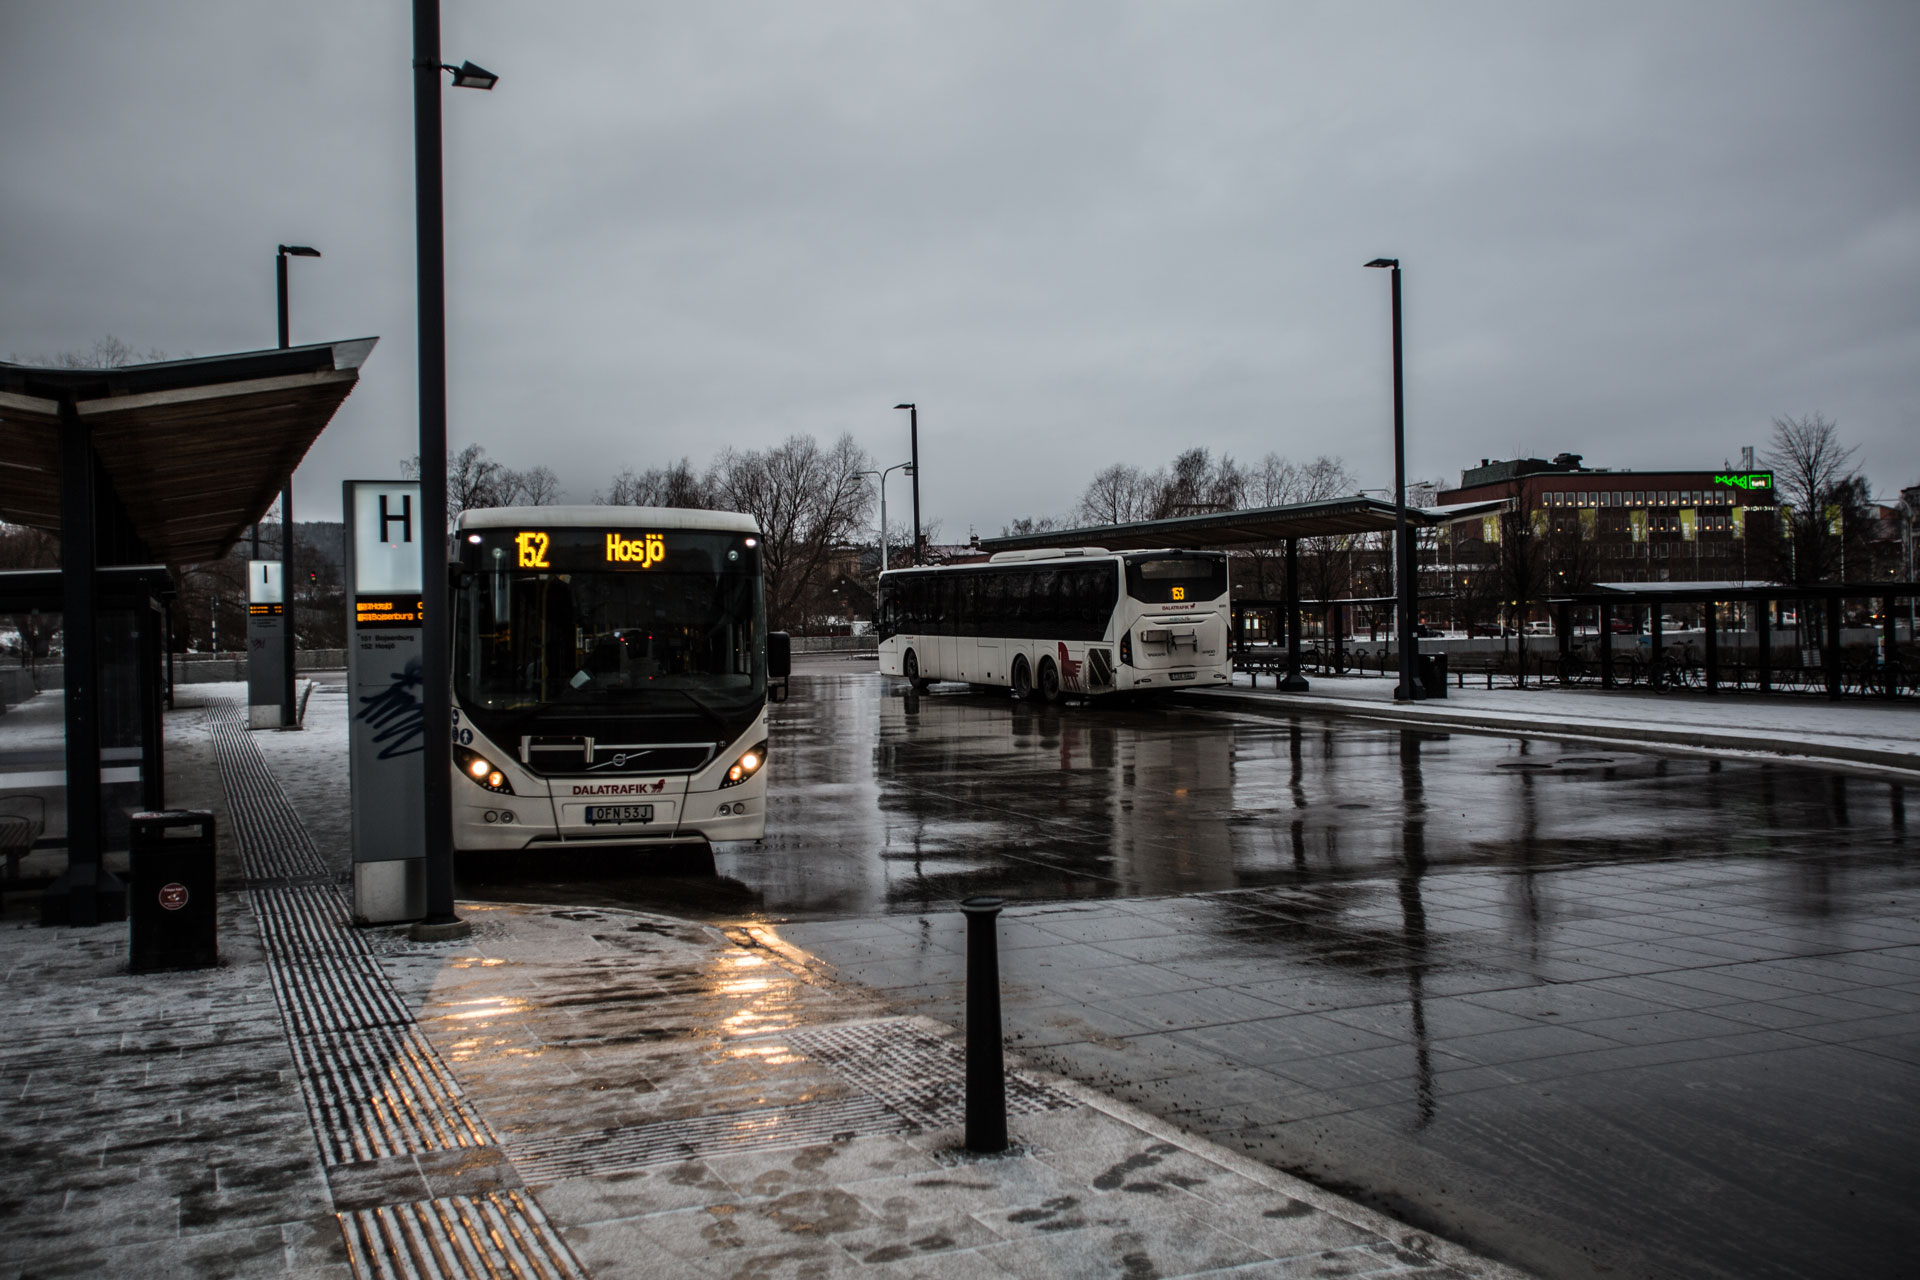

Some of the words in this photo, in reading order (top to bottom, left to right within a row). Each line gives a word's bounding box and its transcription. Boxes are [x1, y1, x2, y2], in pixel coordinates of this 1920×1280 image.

[378, 495, 412, 543] H
[515, 532, 550, 568] 152
[606, 533, 665, 568] Hosjö
[1171, 586, 1185, 601] 153
[573, 784, 647, 795] DALATRAFIK
[596, 808, 620, 819] OFN
[624, 807, 648, 818] 53J
